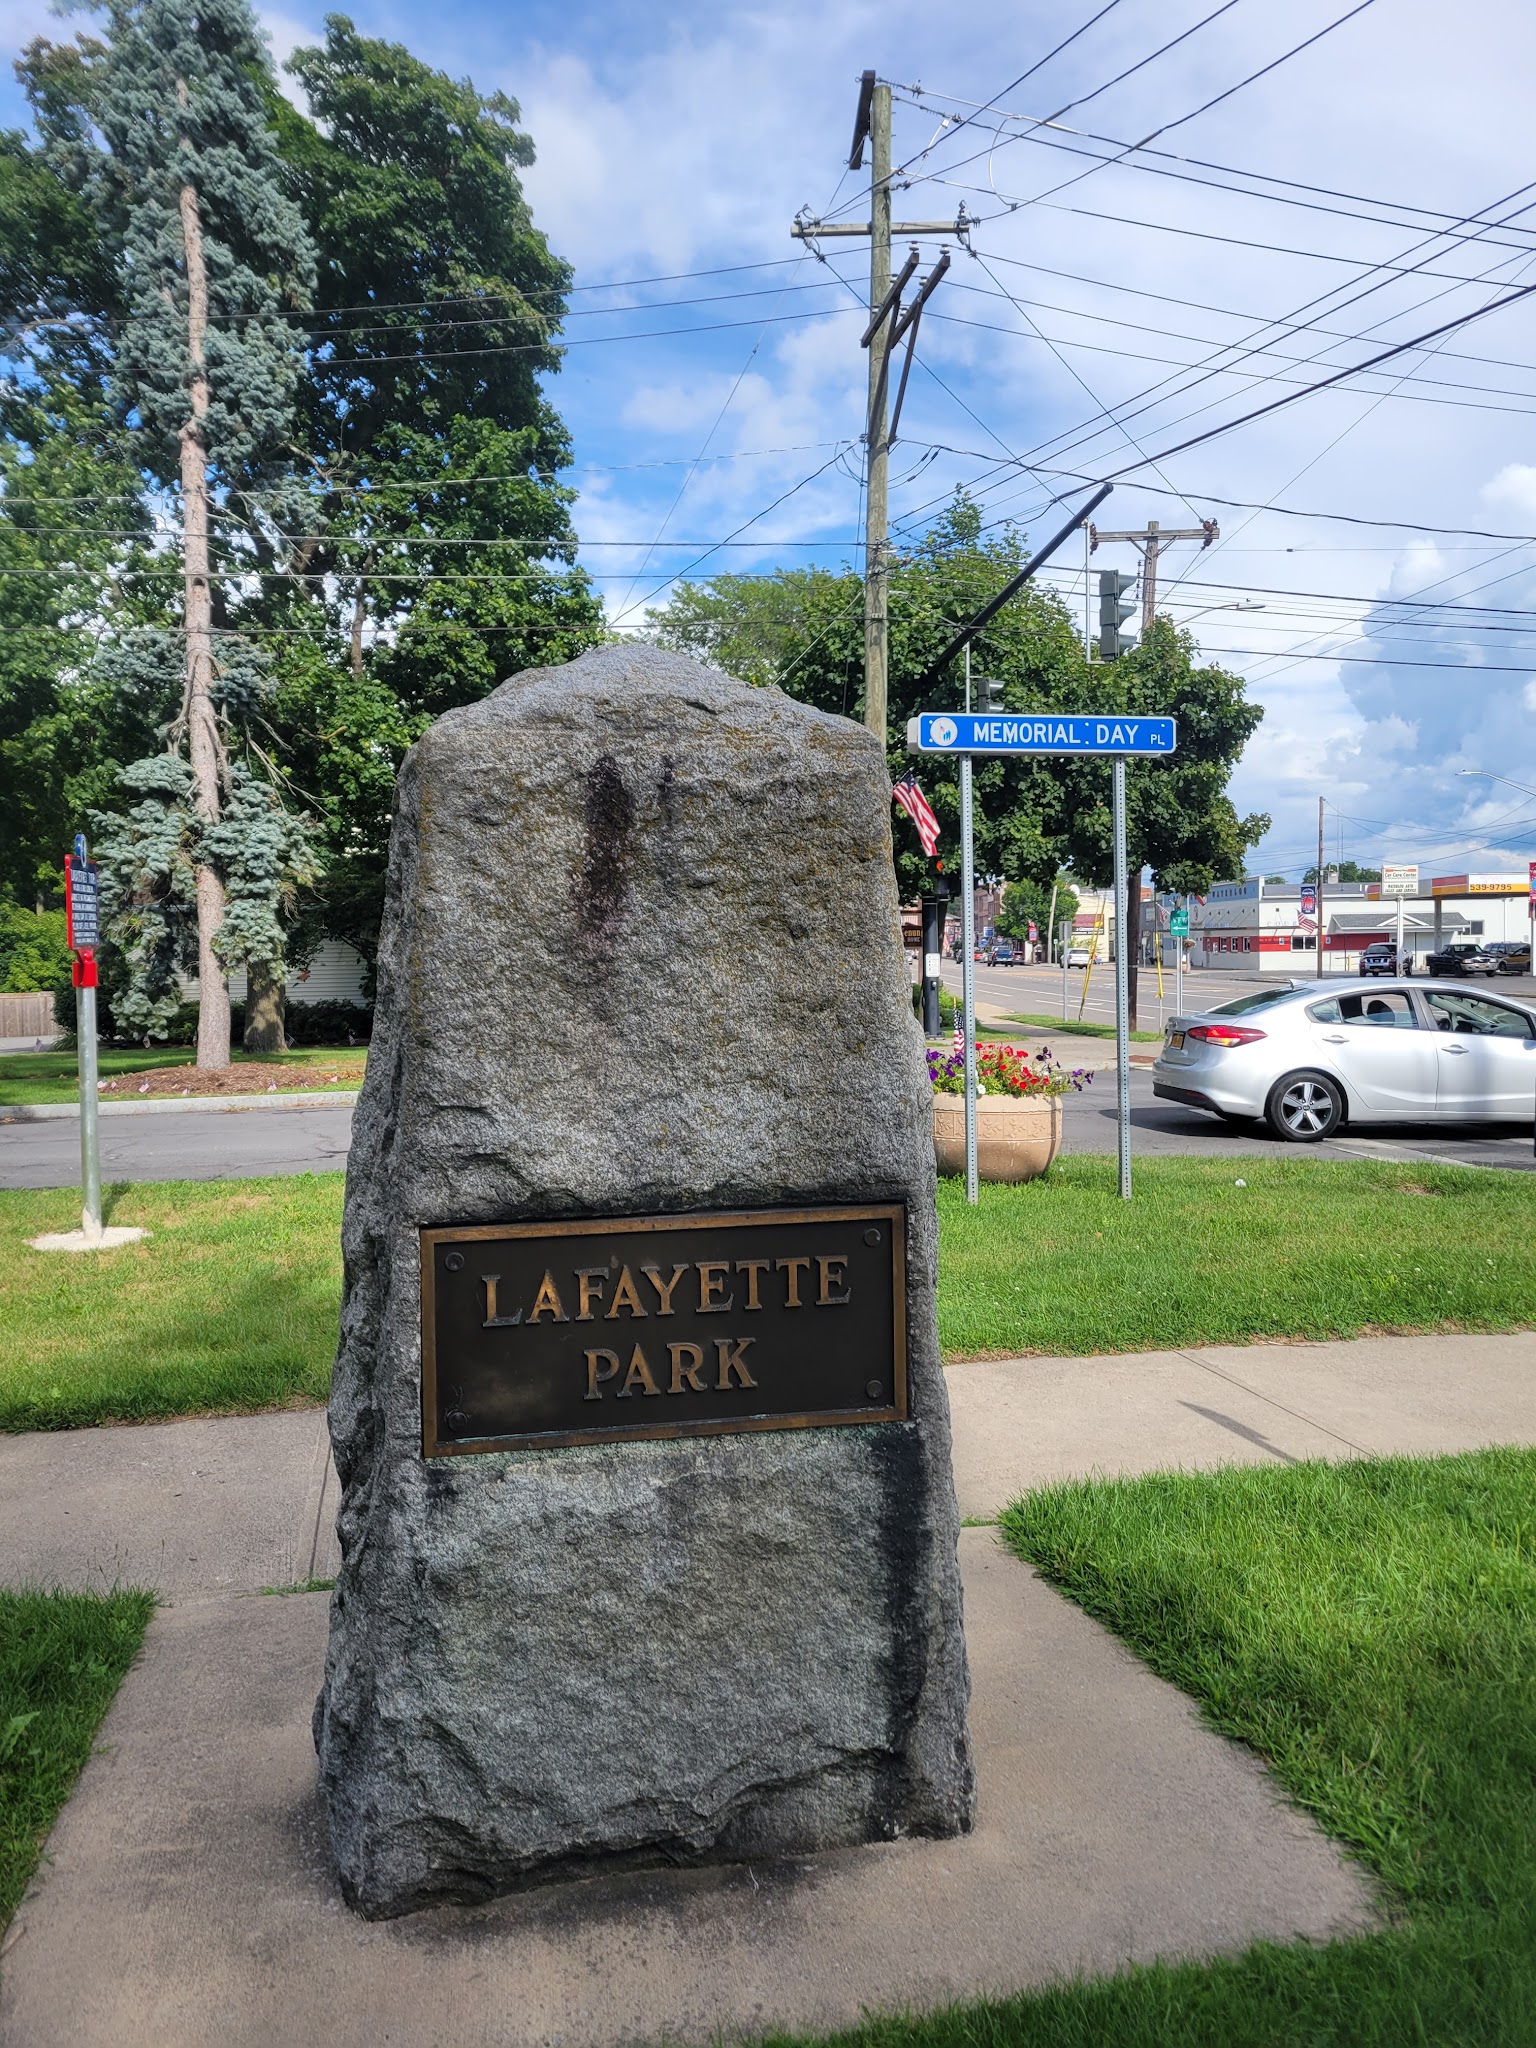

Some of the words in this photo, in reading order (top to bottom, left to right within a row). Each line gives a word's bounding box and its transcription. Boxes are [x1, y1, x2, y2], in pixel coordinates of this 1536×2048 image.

[973, 721, 1081, 744] MEMORIAL
[1096, 724, 1139, 744] DAY
[1150, 734, 1163, 745] PL
[1470, 883, 1512, 891] 539-9795
[480, 1254, 852, 1328] LAFAYETTE
[582, 1336, 759, 1400] PARK
